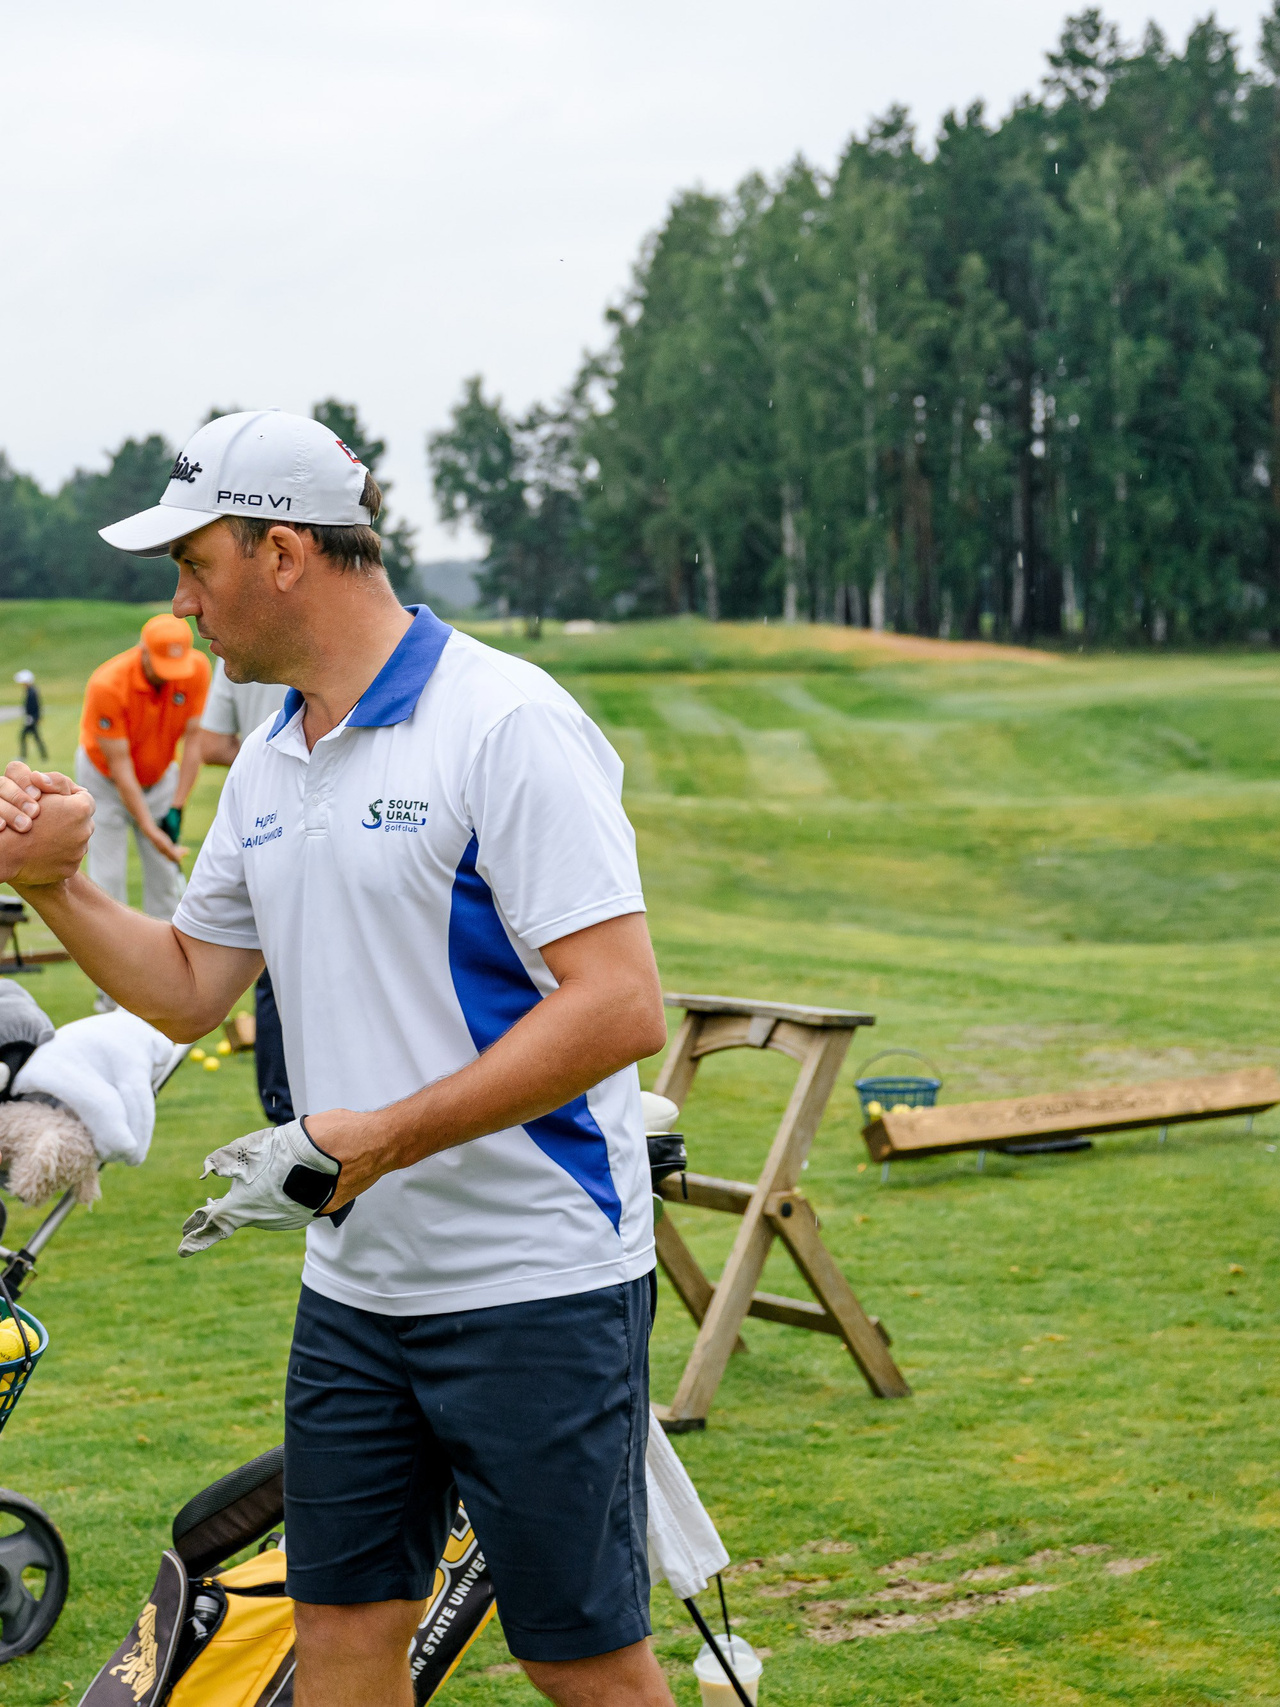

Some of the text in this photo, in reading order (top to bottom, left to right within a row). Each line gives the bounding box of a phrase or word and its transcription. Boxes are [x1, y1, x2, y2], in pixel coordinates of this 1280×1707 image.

[217, 490, 292, 511] PRO V1
[388, 799, 429, 811] SOUTH
[386, 810, 418, 822] URAL
[410, 1656, 427, 1680] RN
[422, 1605, 458, 1656] STATE
